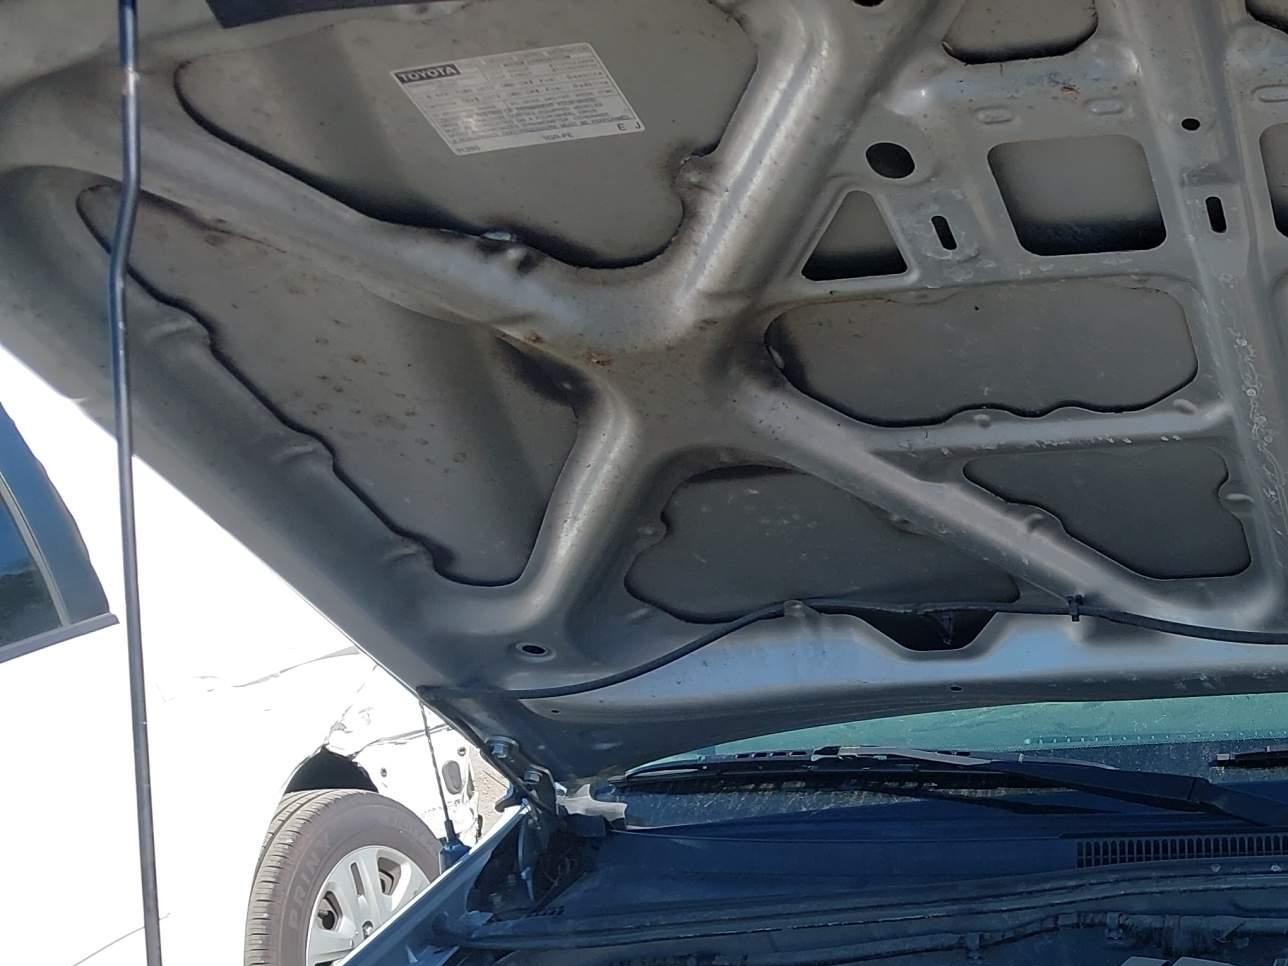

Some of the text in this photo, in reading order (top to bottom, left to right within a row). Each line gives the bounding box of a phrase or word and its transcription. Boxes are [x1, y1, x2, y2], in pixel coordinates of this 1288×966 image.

[400, 66, 457, 82] TOYOTA
[617, 122, 627, 131] E
[289, 830, 334, 928] PRINX
